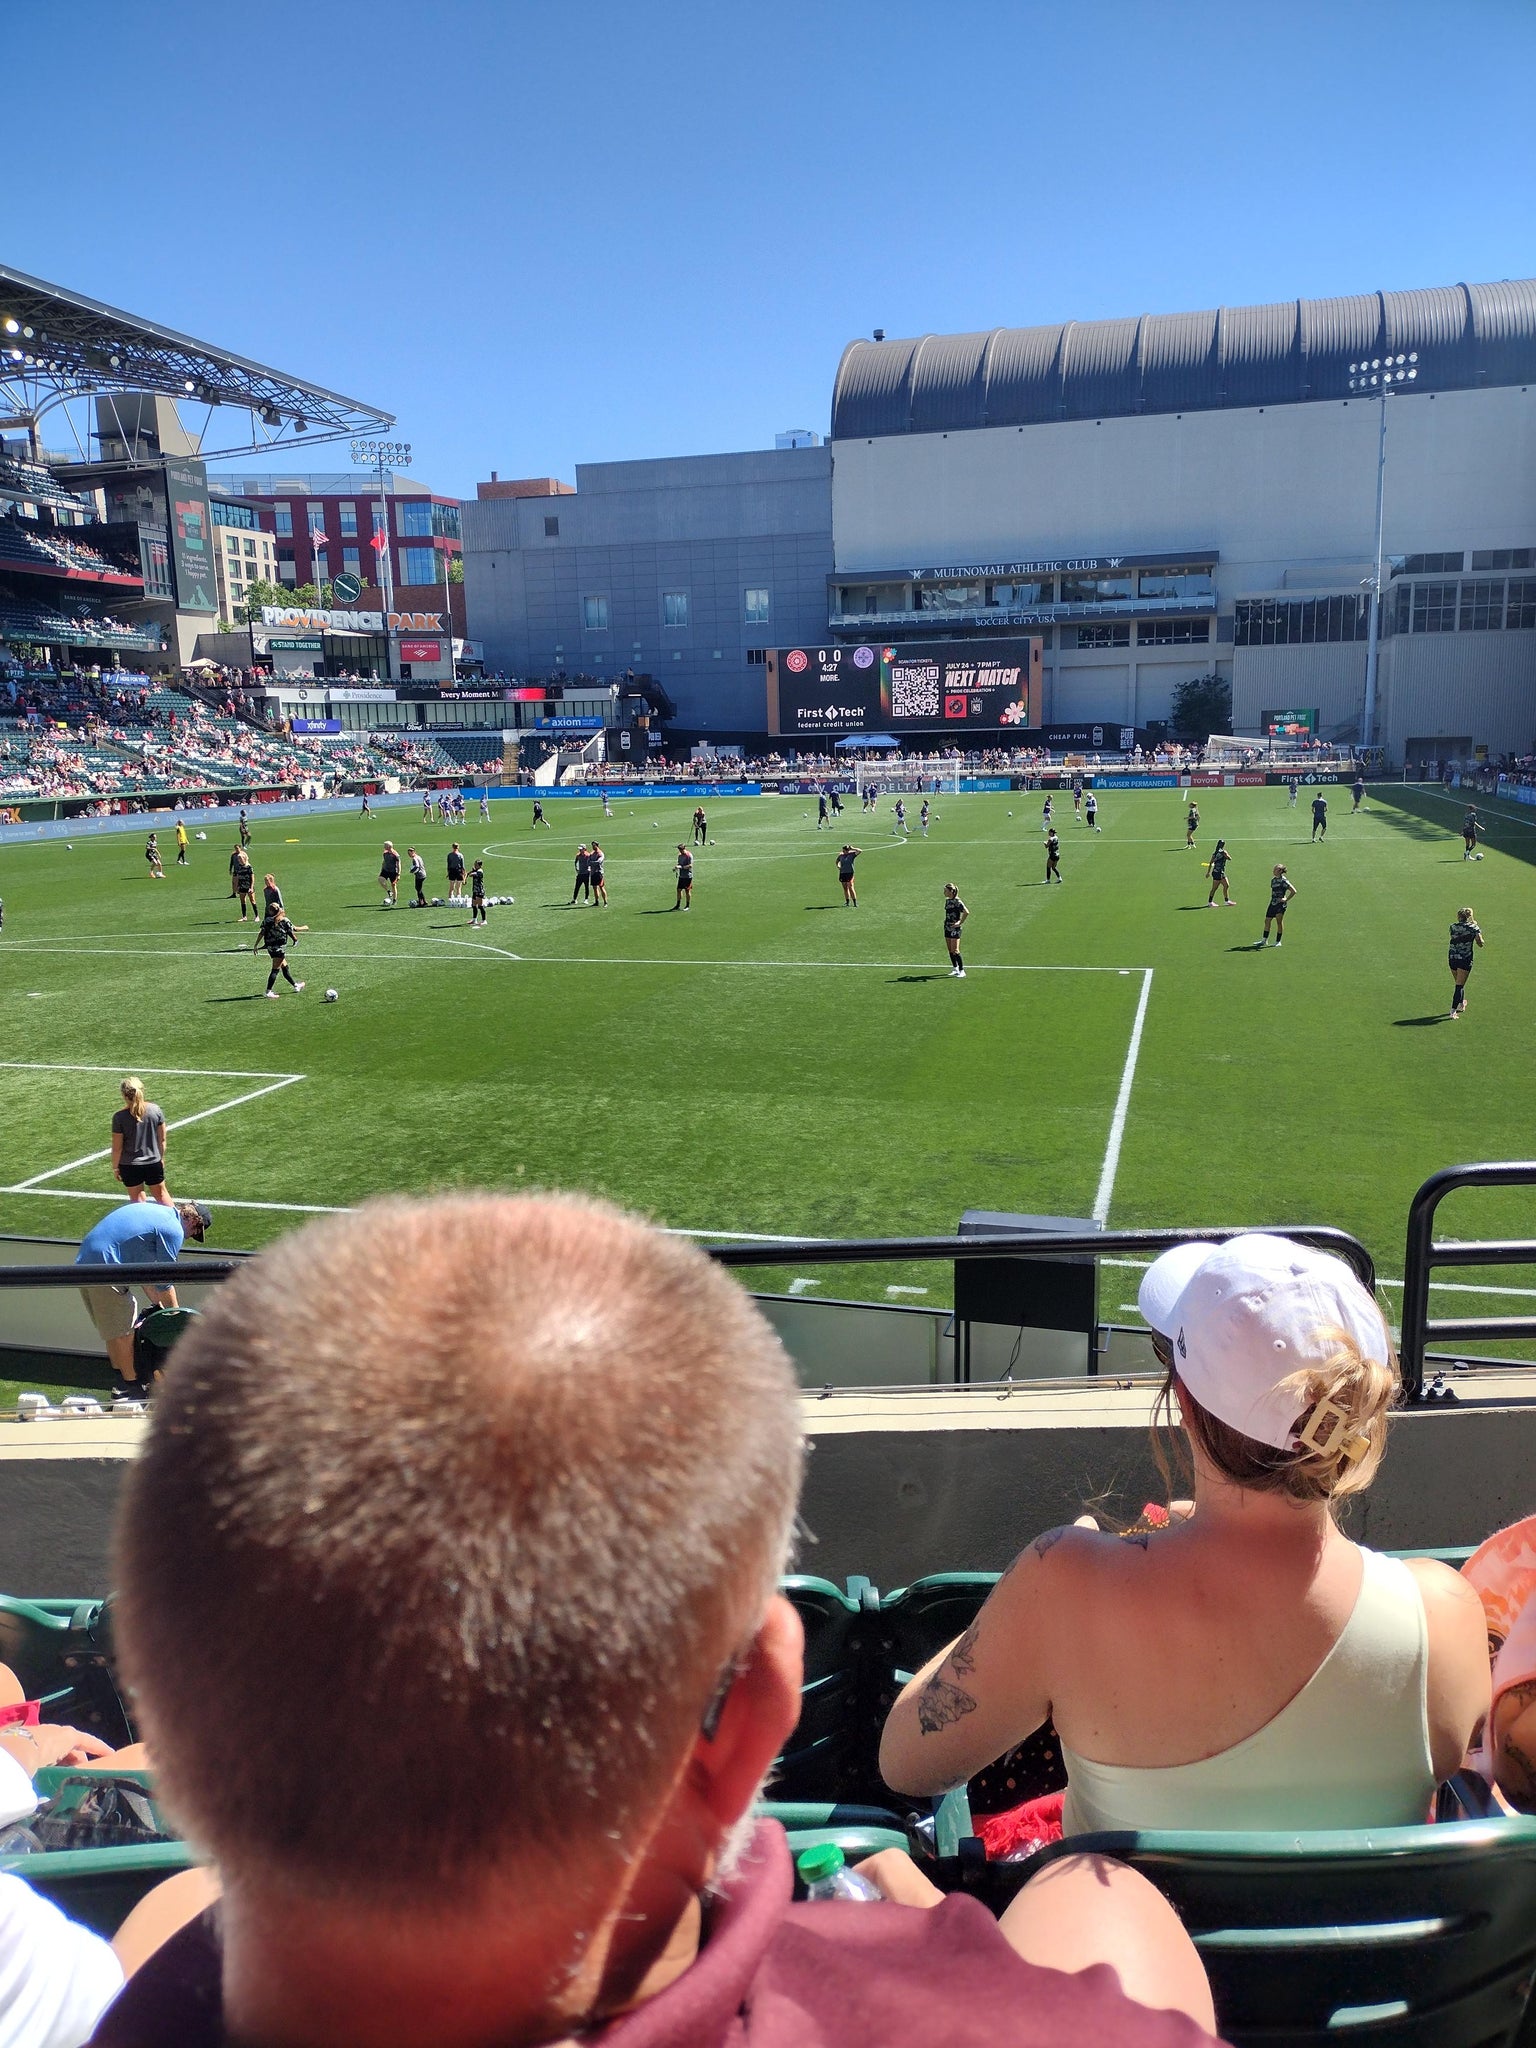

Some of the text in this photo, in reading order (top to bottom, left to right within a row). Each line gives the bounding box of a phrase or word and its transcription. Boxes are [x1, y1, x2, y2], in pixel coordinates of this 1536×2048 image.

[934, 566, 1004, 578] MULTNOMAH
[1009, 561, 1061, 574] ATHLETIC
[1067, 560, 1098, 570] CLUB
[261, 606, 444, 632] PROVIDENCE PARK
[975, 615, 1056, 627] SOCCER CITY USA
[818, 650, 841, 662] 0 0
[822, 663, 838, 671] 4:27
[945, 668, 1020, 687] NEXT MATCH
[441, 691, 460, 699] Every
[797, 708, 823, 718] First
[307, 721, 326, 730] xfinity
[406, 722, 423, 730] Ford
[552, 718, 581, 726] axiom
[640, 787, 652, 795] ring
[783, 783, 800, 793] ally
[833, 783, 850, 793] ally
